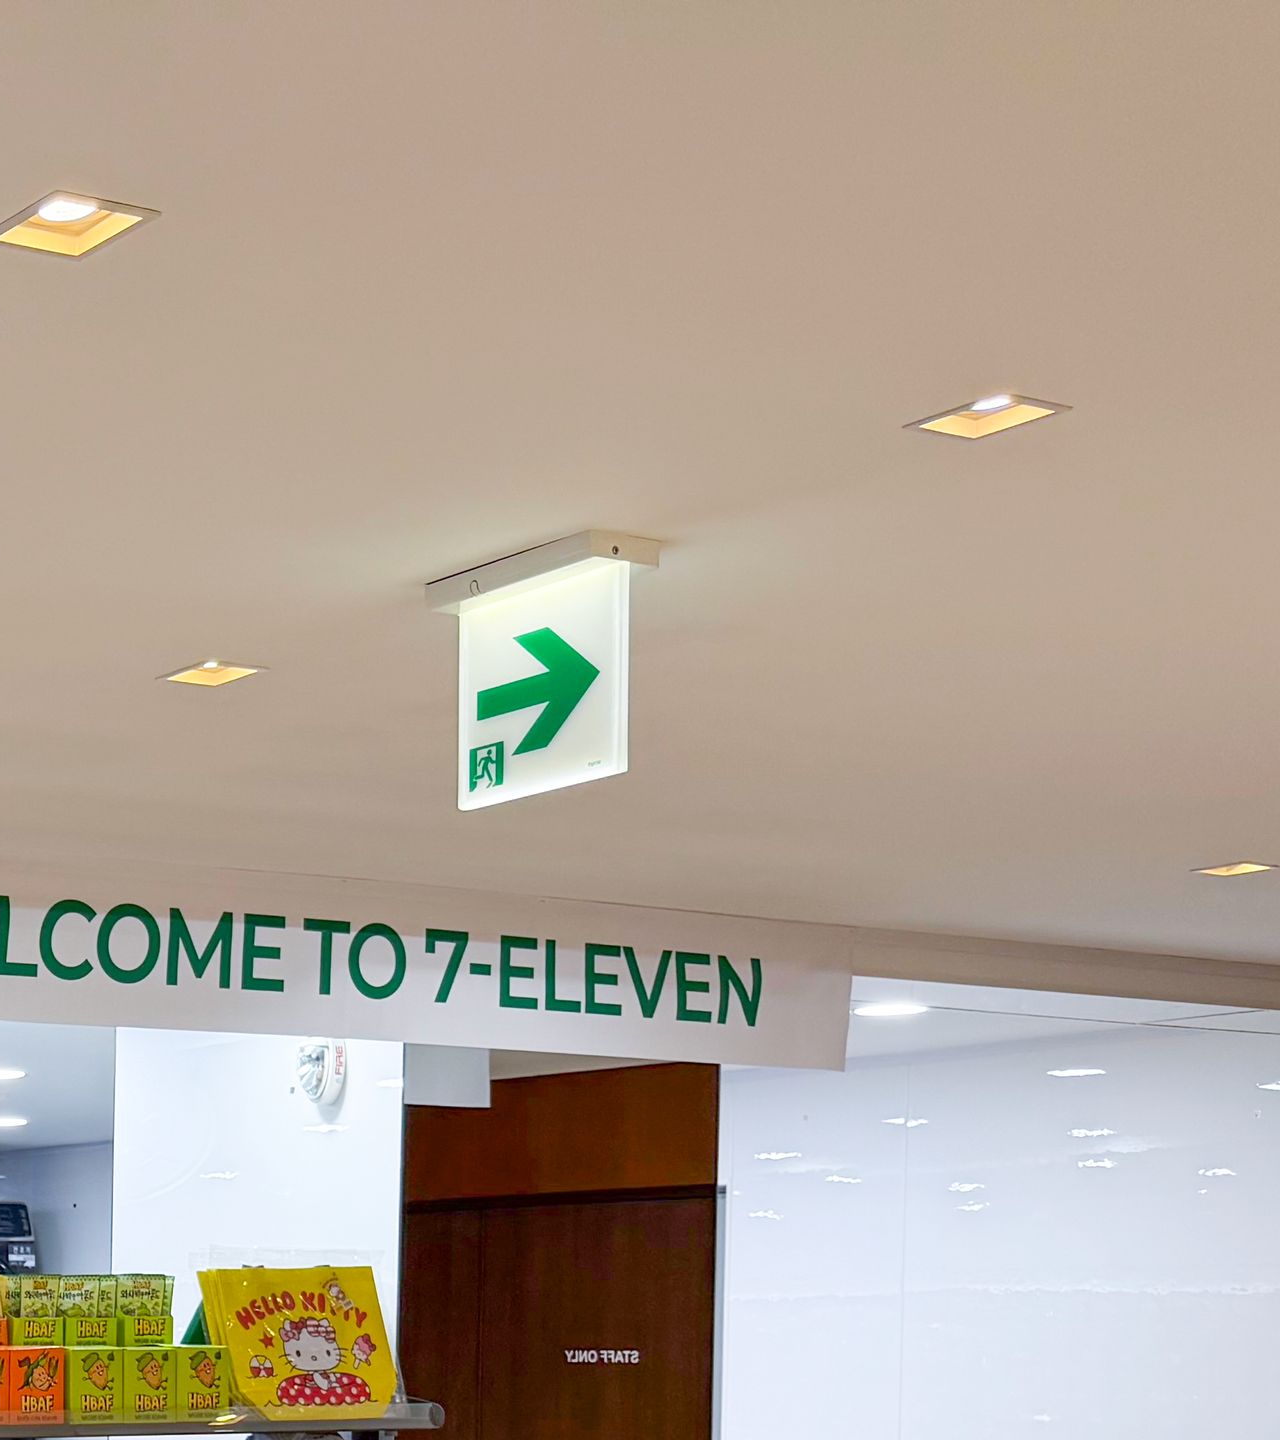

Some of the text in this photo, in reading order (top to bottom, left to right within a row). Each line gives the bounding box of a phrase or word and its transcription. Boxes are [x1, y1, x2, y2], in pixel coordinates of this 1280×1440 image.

[304, 916, 407, 1000] TO
[425, 928, 762, 1028] 7-ELEVEN
[334, 1045, 343, 1075] FIRE
[235, 1291, 368, 1330] HELLO KIY
[24, 1320, 56, 1338] HBAF
[81, 1395, 114, 1413] HBAF
